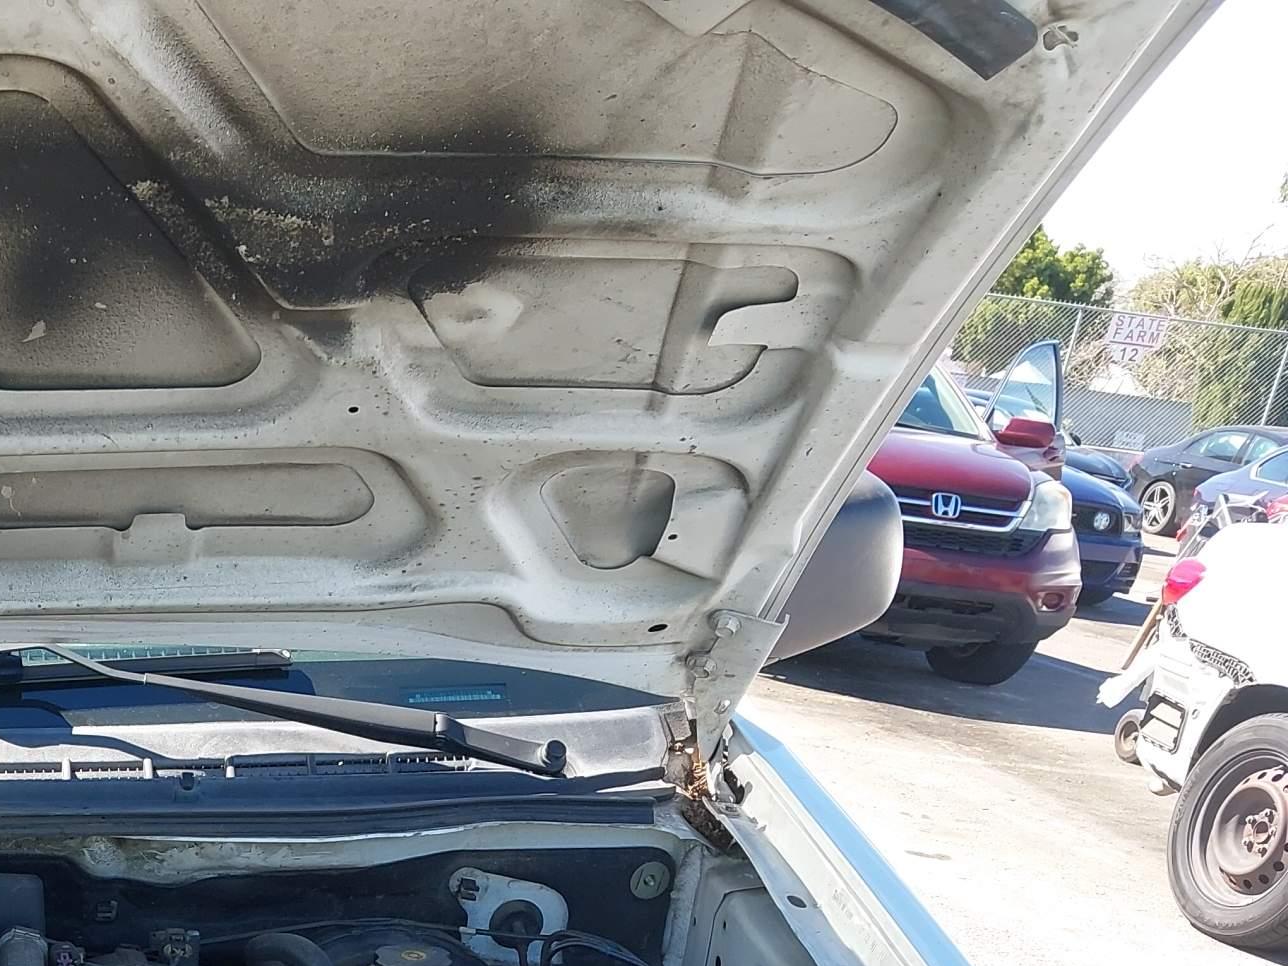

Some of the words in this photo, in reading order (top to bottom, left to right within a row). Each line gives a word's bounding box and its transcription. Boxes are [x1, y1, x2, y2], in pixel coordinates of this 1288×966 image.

[1115, 314, 1166, 332] STATE
[1112, 327, 1160, 344] FARM
[1120, 347, 1139, 362] 12
